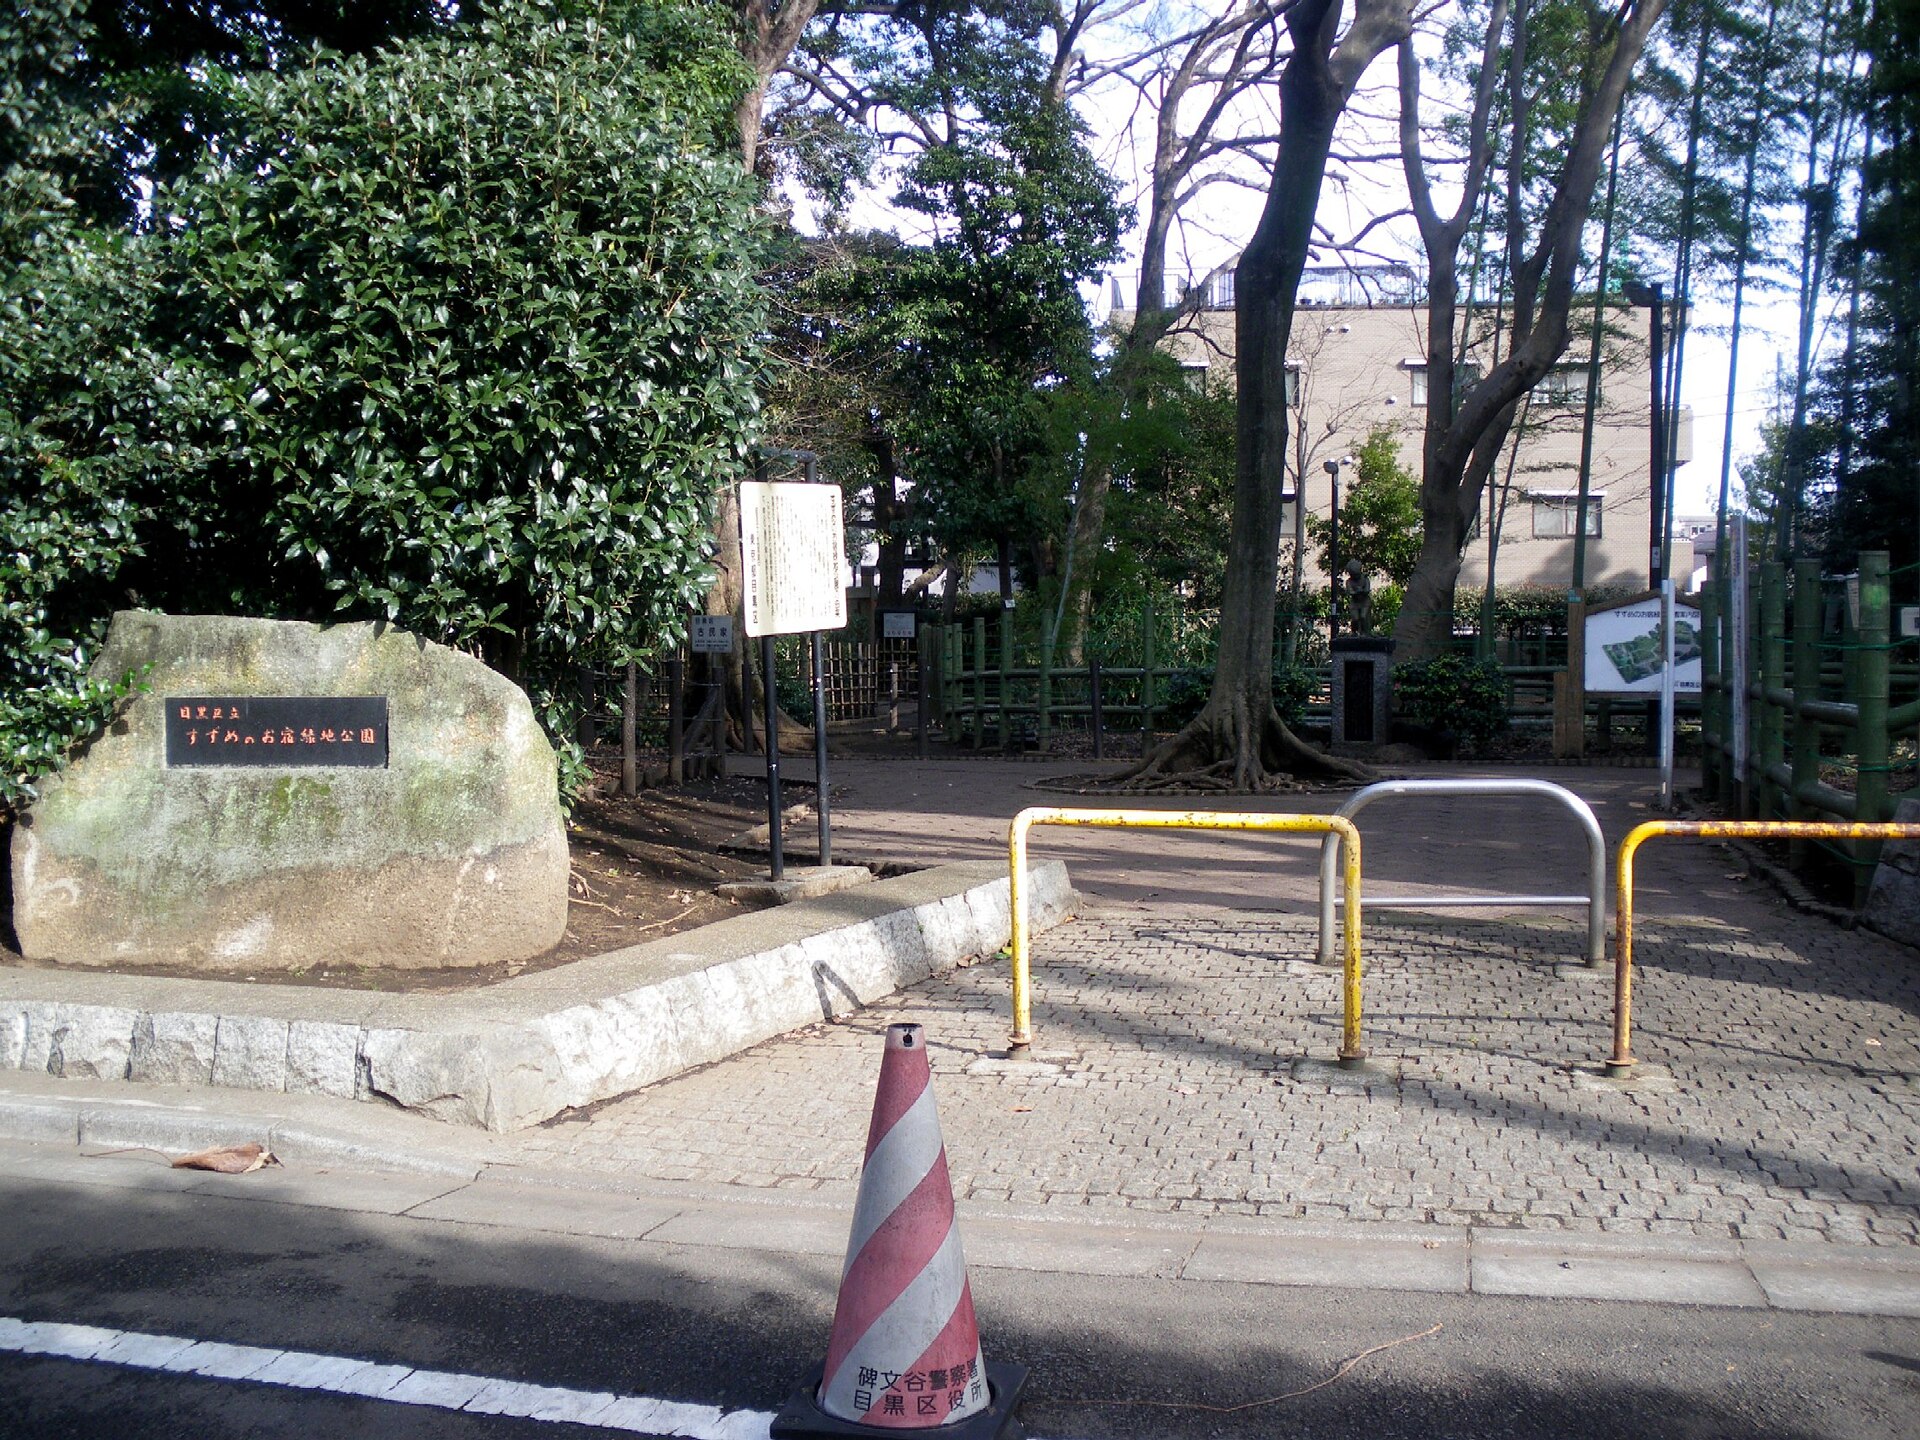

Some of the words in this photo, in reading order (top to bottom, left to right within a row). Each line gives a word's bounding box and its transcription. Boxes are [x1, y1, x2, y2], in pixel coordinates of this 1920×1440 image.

[697, 626, 728, 638] 古民家
[179, 706, 241, 720] 目黒区立
[186, 725, 376, 746] すずめのお宿緑地公園
[858, 1358, 979, 1394] 碑文谷警察署
[854, 1379, 983, 1417] 目黒区役所
